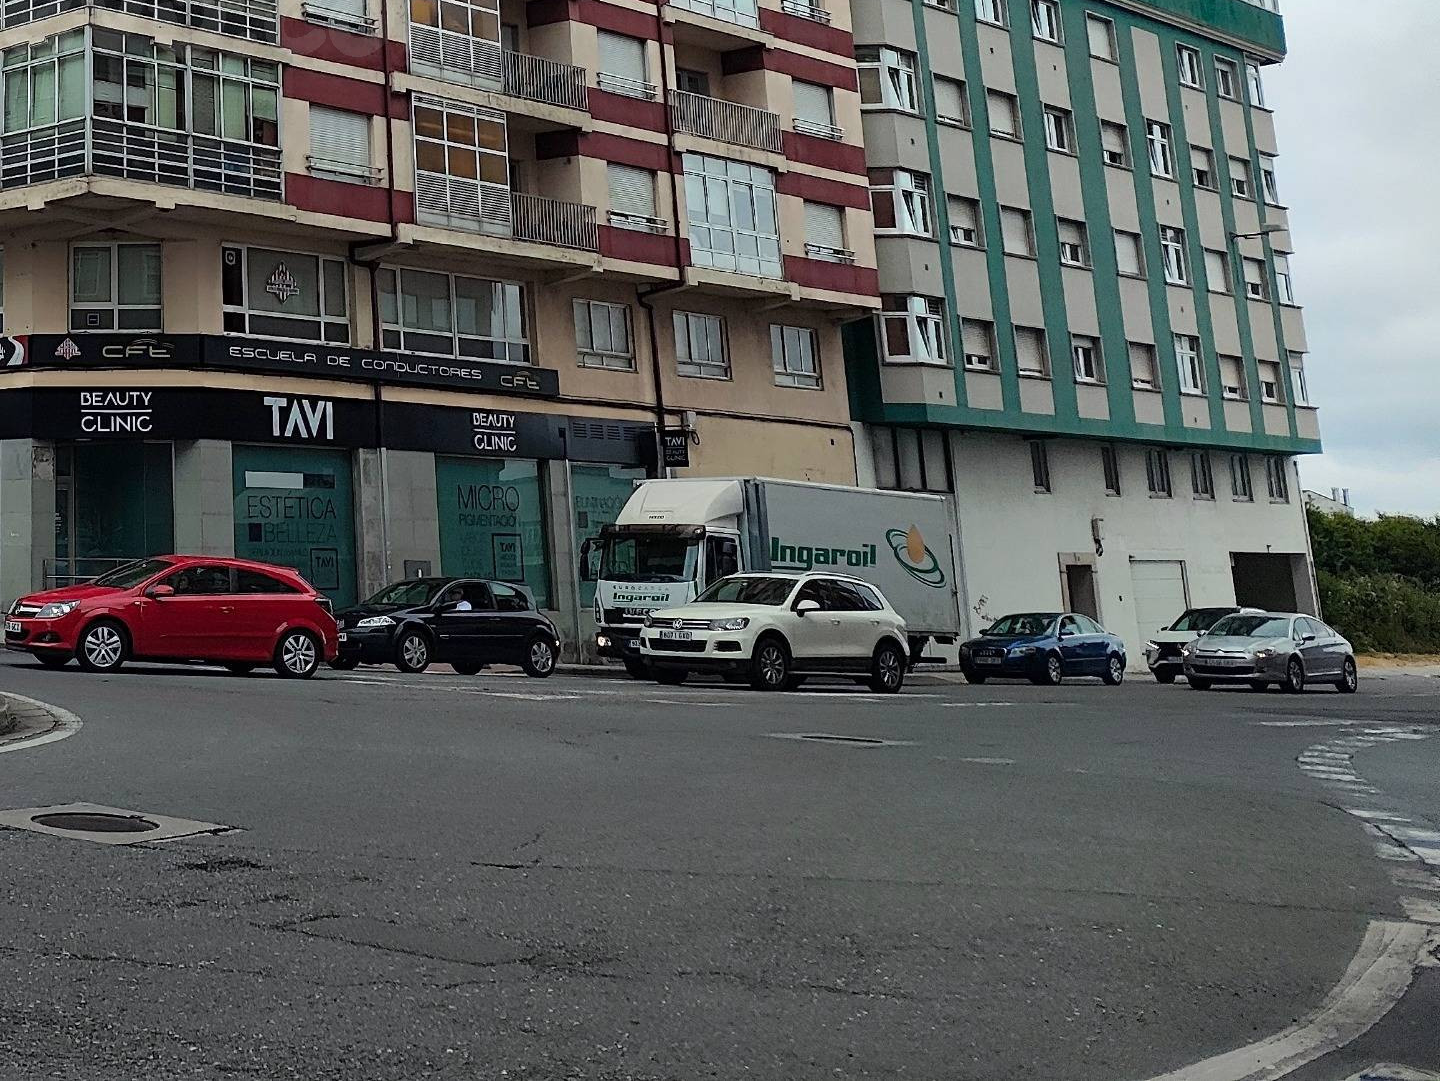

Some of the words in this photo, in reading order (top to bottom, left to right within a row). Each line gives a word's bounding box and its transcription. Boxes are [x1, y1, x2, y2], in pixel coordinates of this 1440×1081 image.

[229, 346, 317, 363] ESCUELA
[327, 355, 351, 367] DE
[361, 358, 482, 380] CONDUCTORES
[80, 391, 153, 406] BEAUTY
[81, 415, 153, 432] CLINIC
[263, 396, 334, 440] TAVI
[472, 412, 515, 428] BEAUTY
[474, 434, 517, 452] CLINIC
[664, 436, 685, 447] TAVI
[247, 490, 337, 519] ESTÉTICA
[457, 484, 520, 512] MICRO
[315, 556, 334, 568] TAVI
[771, 536, 877, 571] Ingaroil
[612, 592, 670, 603] Ingaroil
